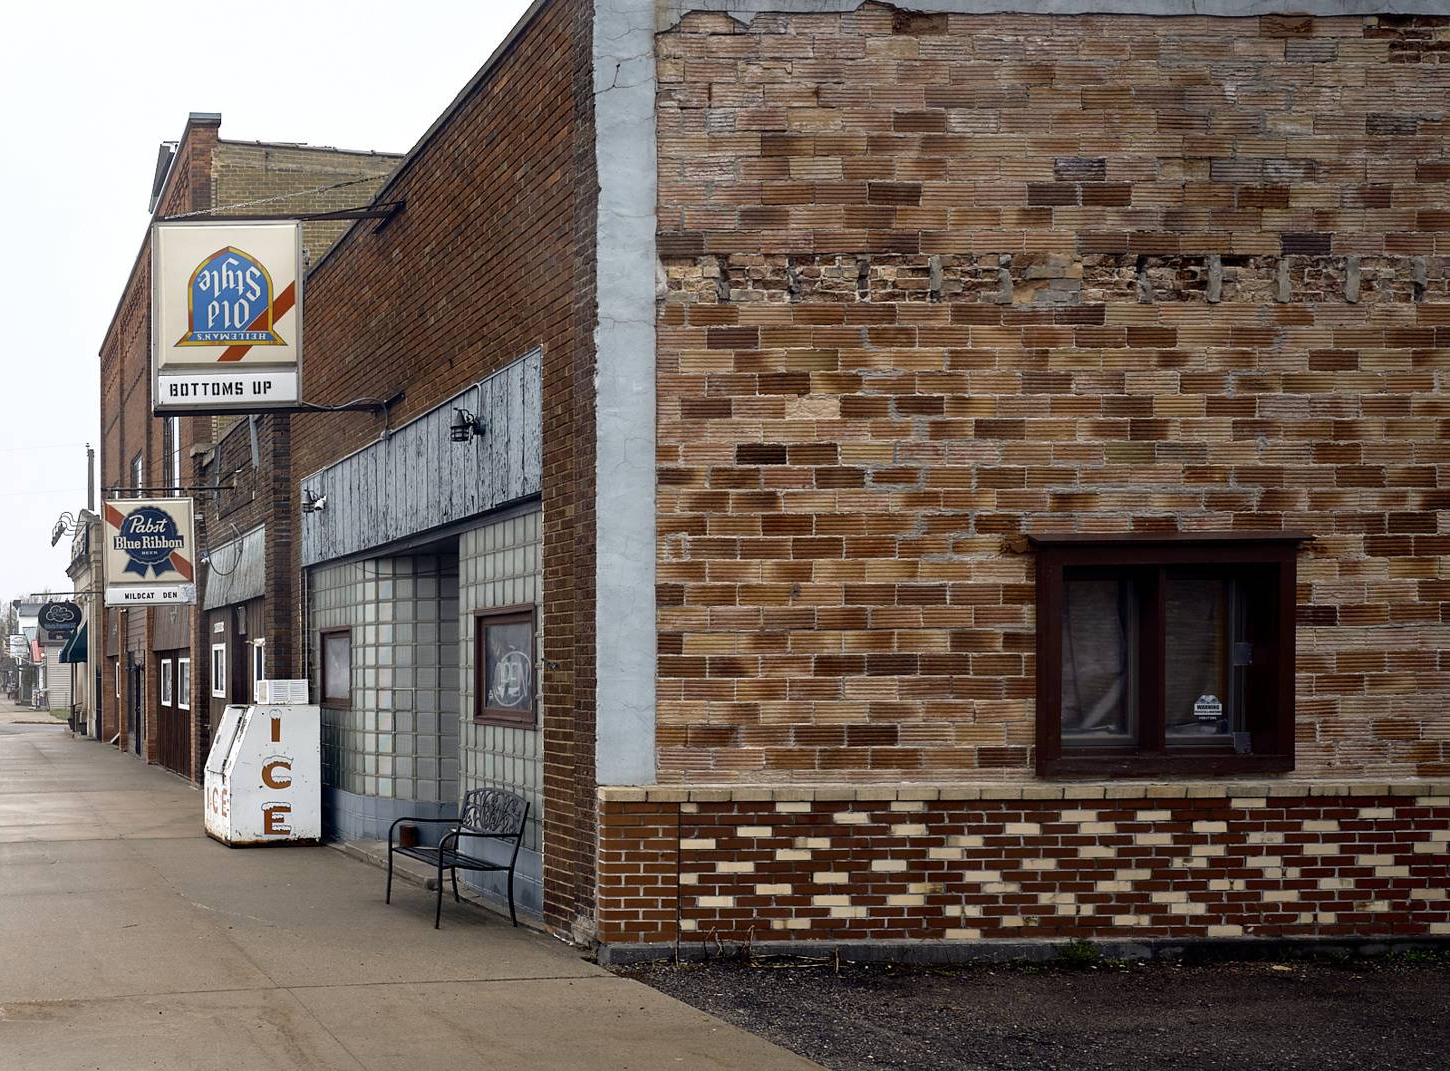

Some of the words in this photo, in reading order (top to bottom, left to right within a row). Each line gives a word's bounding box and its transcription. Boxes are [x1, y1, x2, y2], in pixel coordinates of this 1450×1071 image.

[198, 257, 261, 302] Style
[207, 298, 250, 329] Old
[197, 333, 266, 341] HEILEMAN'S
[169, 382, 244, 397] BOTTOMS
[253, 381, 272, 395] UP
[128, 514, 168, 534] Pabst
[114, 536, 141, 550] Blue
[142, 535, 183, 549] Ribbon
[124, 592, 155, 600] WILDCAT
[206, 786, 229, 818] ICE
